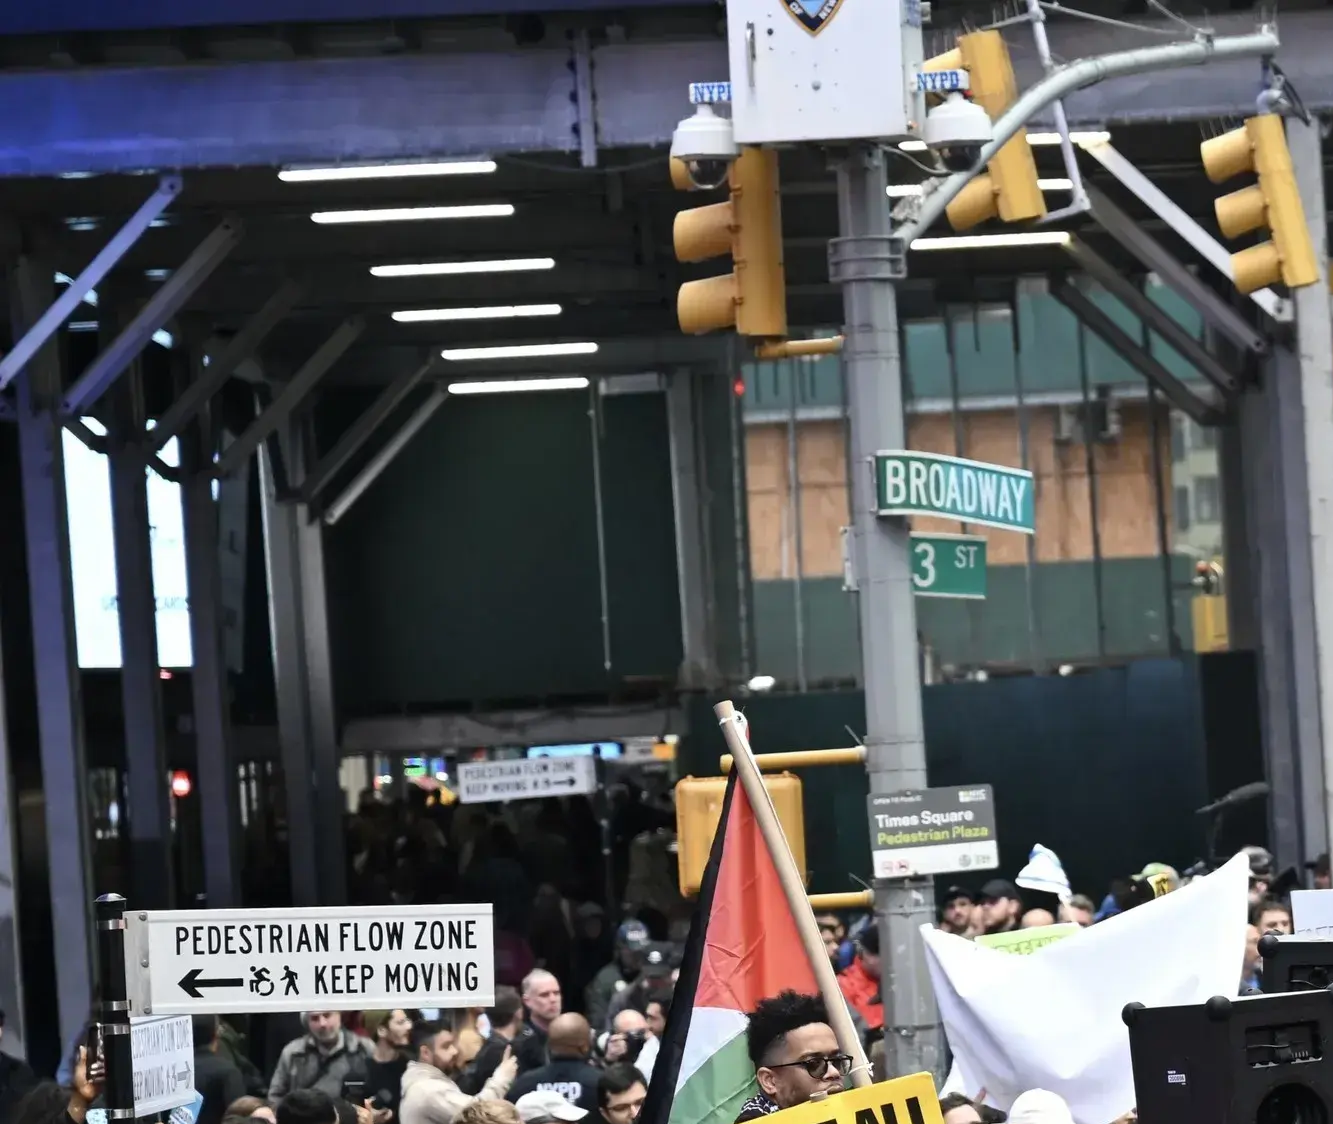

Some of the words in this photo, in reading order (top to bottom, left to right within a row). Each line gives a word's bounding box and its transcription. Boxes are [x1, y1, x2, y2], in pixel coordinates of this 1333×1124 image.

[917, 71, 960, 91] NYPD
[886, 460, 1026, 522] BROADWAY
[955, 545, 978, 569] ST
[874, 814, 919, 829] Times
[920, 810, 975, 826] Square
[877, 829, 950, 845] Pedestrian
[952, 825, 989, 839] Plaza
[175, 923, 330, 956] PEDESTRIAN
[339, 921, 405, 953] FLOW
[414, 919, 478, 951] ZONE
[314, 965, 374, 995] KEEP
[384, 962, 479, 993] MOVING
[536, 1081, 582, 1098] NYPD
